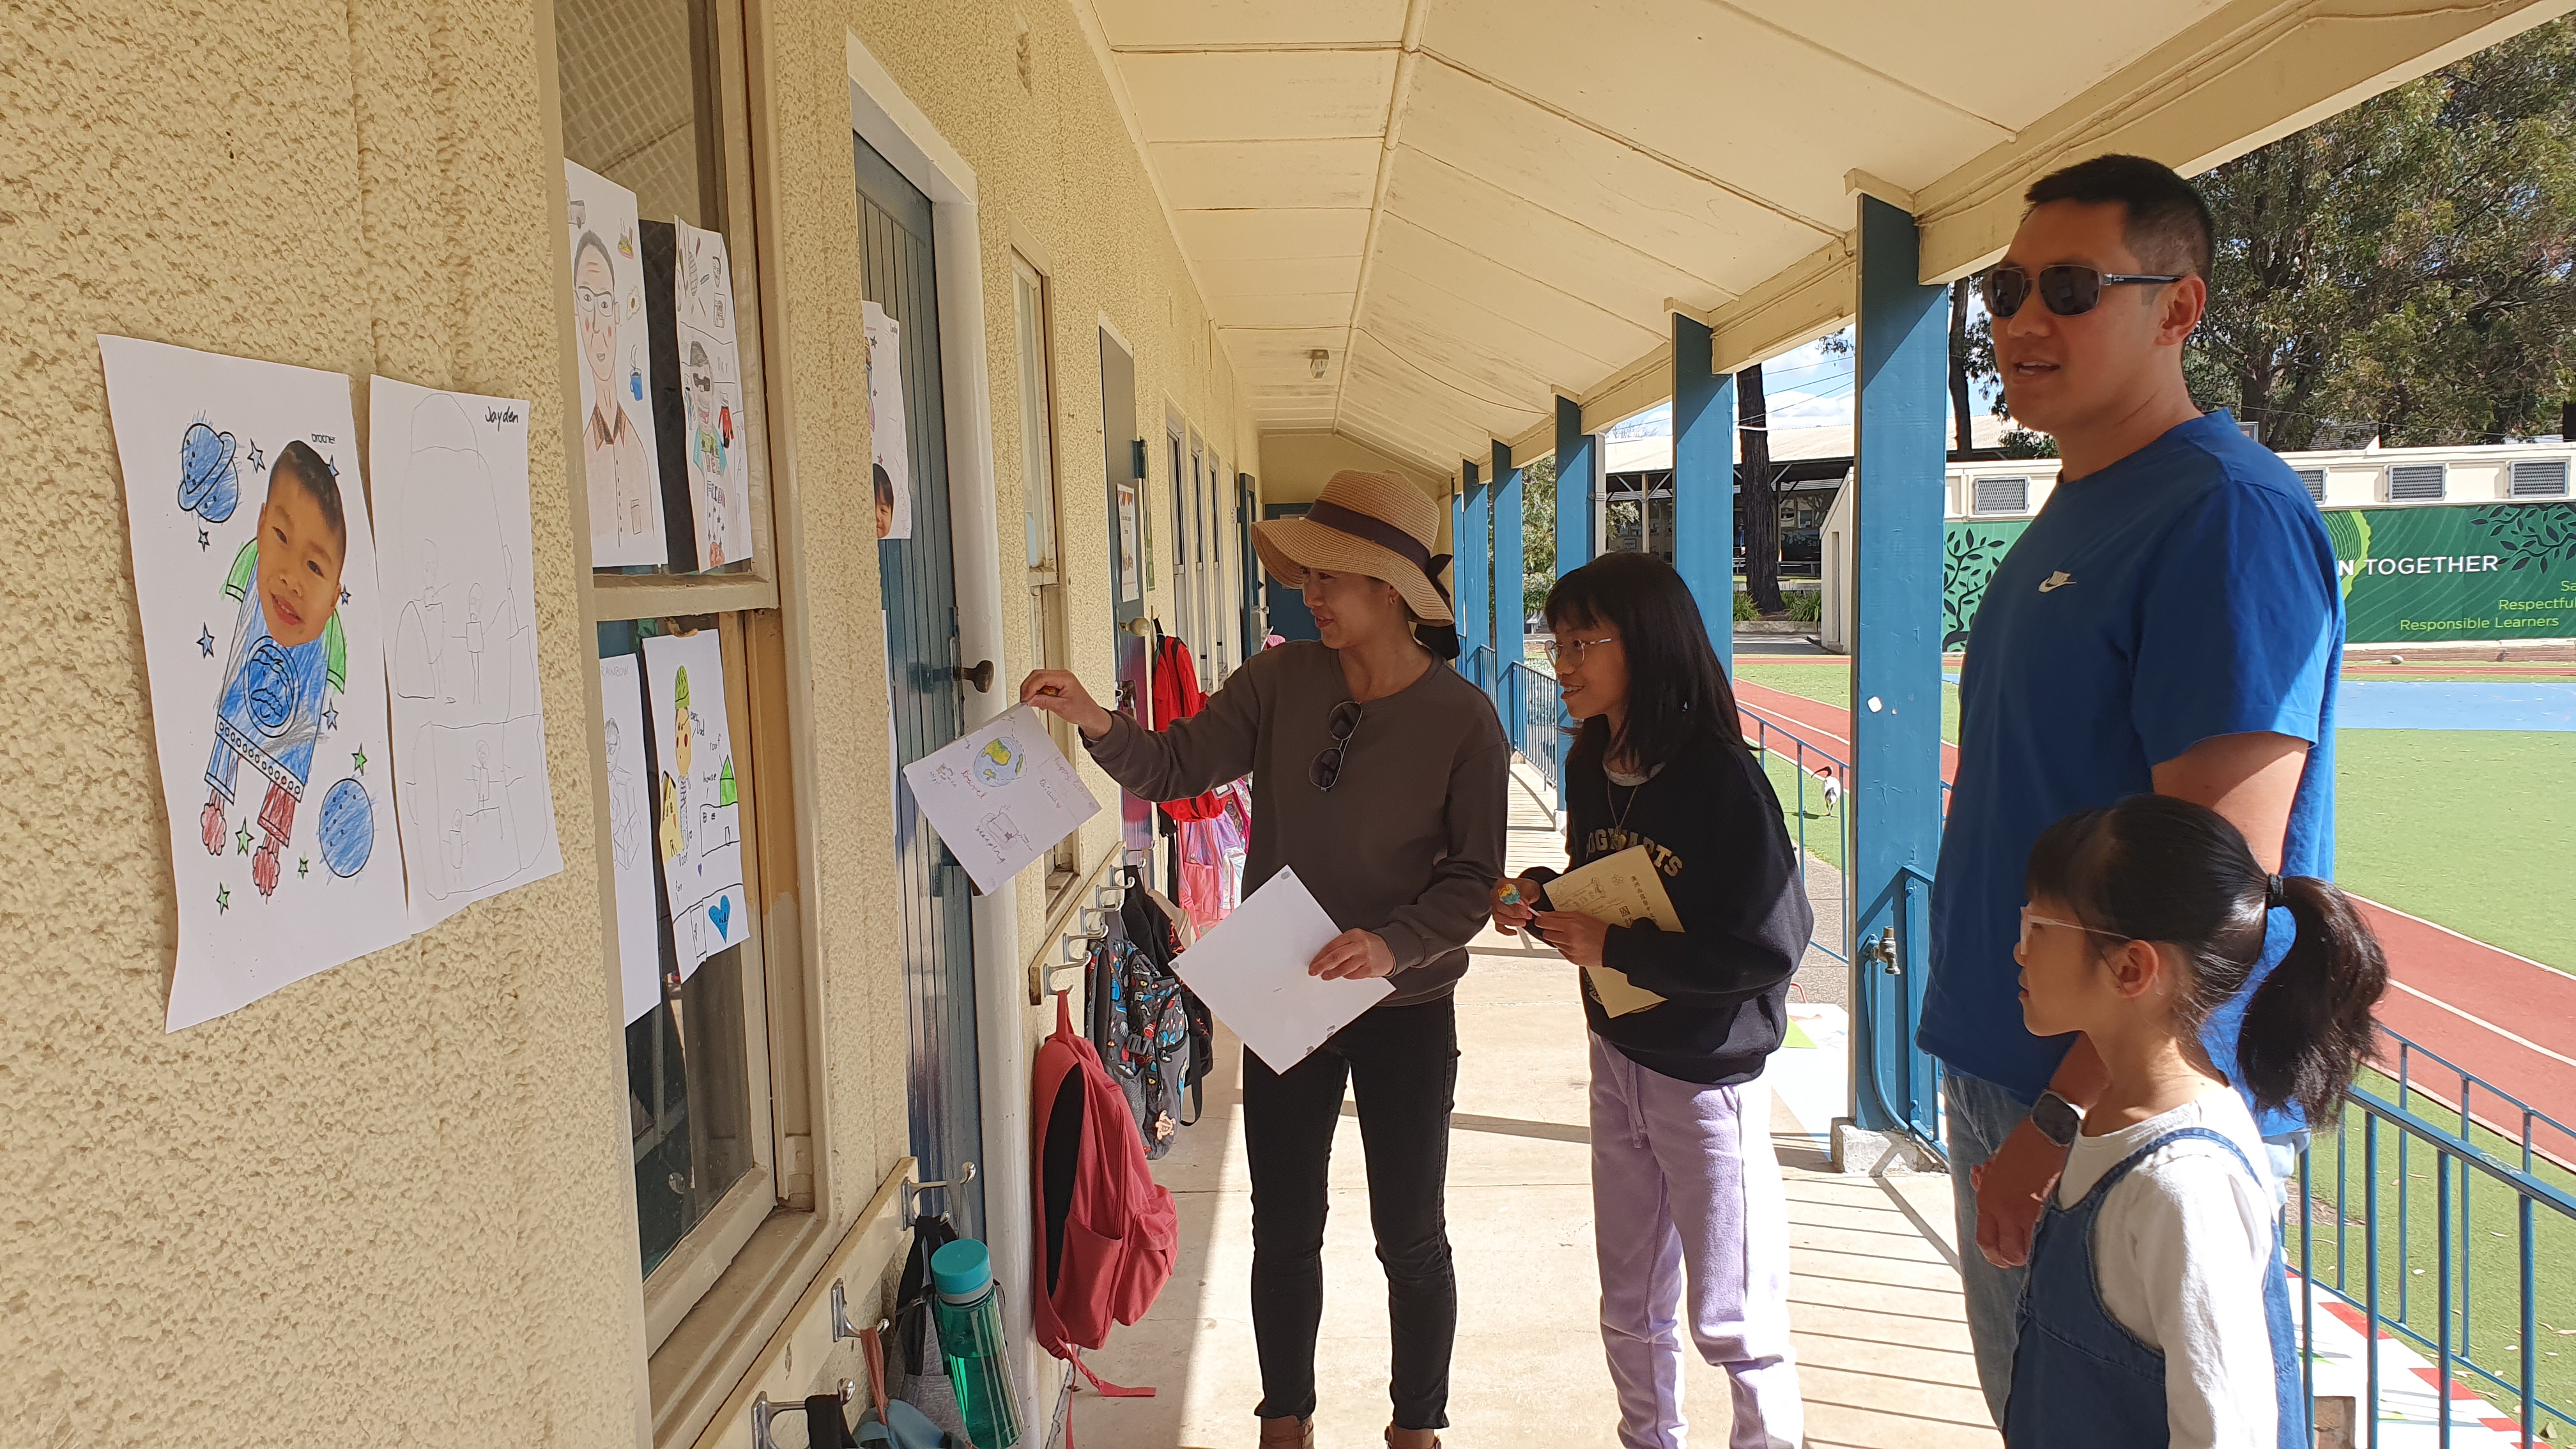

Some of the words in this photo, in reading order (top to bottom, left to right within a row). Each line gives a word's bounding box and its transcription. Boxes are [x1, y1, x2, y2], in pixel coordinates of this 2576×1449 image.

[485, 406, 519, 432] Jayden
[2363, 555, 2499, 576] TOGETHER
[2560, 580, 2576, 592] Sa
[2499, 597, 2576, 614] Respectful
[2400, 617, 2490, 632] Responsible
[2495, 616, 2559, 628] Learners
[709, 733, 721, 751] roof
[703, 770, 717, 783] house
[960, 769, 988, 800] travel
[1585, 828, 1682, 877] OGARTS
